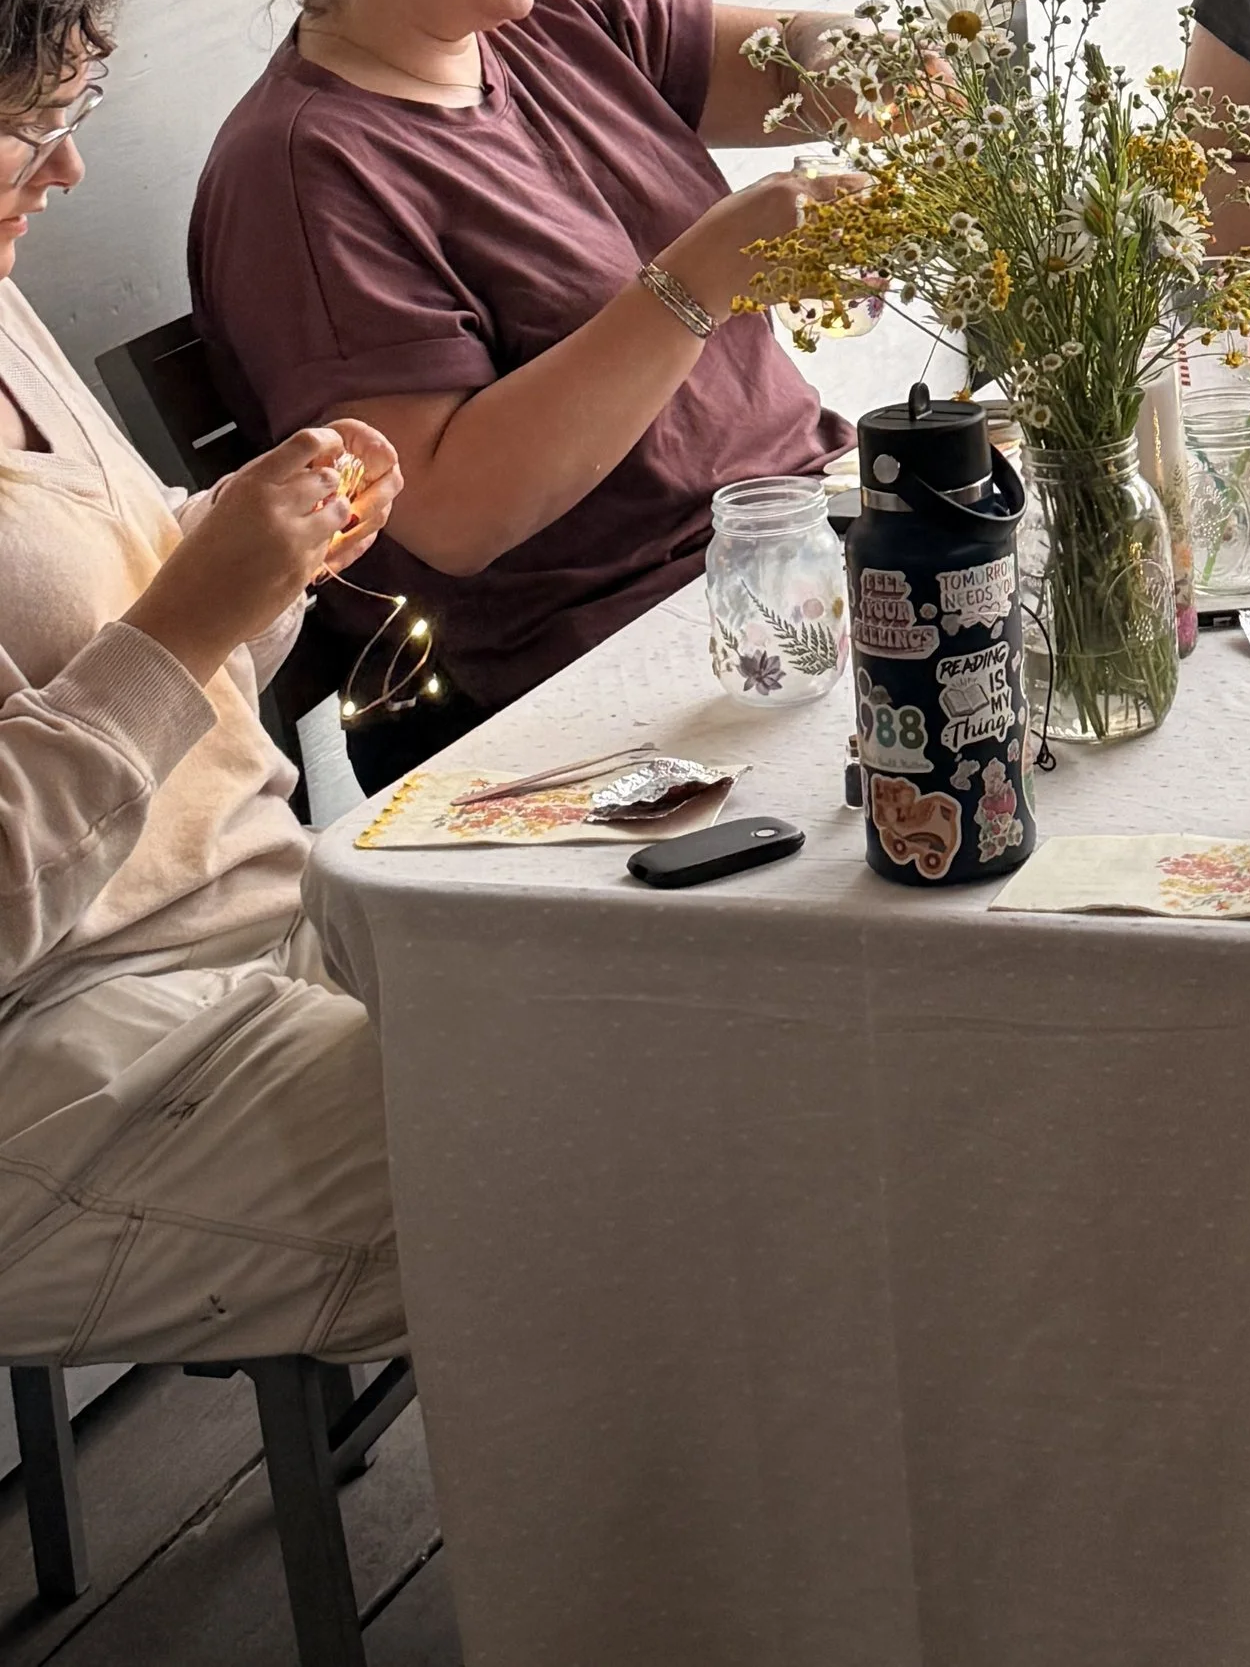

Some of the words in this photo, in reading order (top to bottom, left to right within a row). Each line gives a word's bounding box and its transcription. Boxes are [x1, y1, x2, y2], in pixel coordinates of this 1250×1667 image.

[863, 573, 908, 596] FEEL
[944, 585, 994, 610] NEEDS
[863, 599, 911, 625] YOUR
[940, 644, 1007, 680] READING
[989, 668, 1005, 693] IS
[990, 687, 1010, 715] MY
